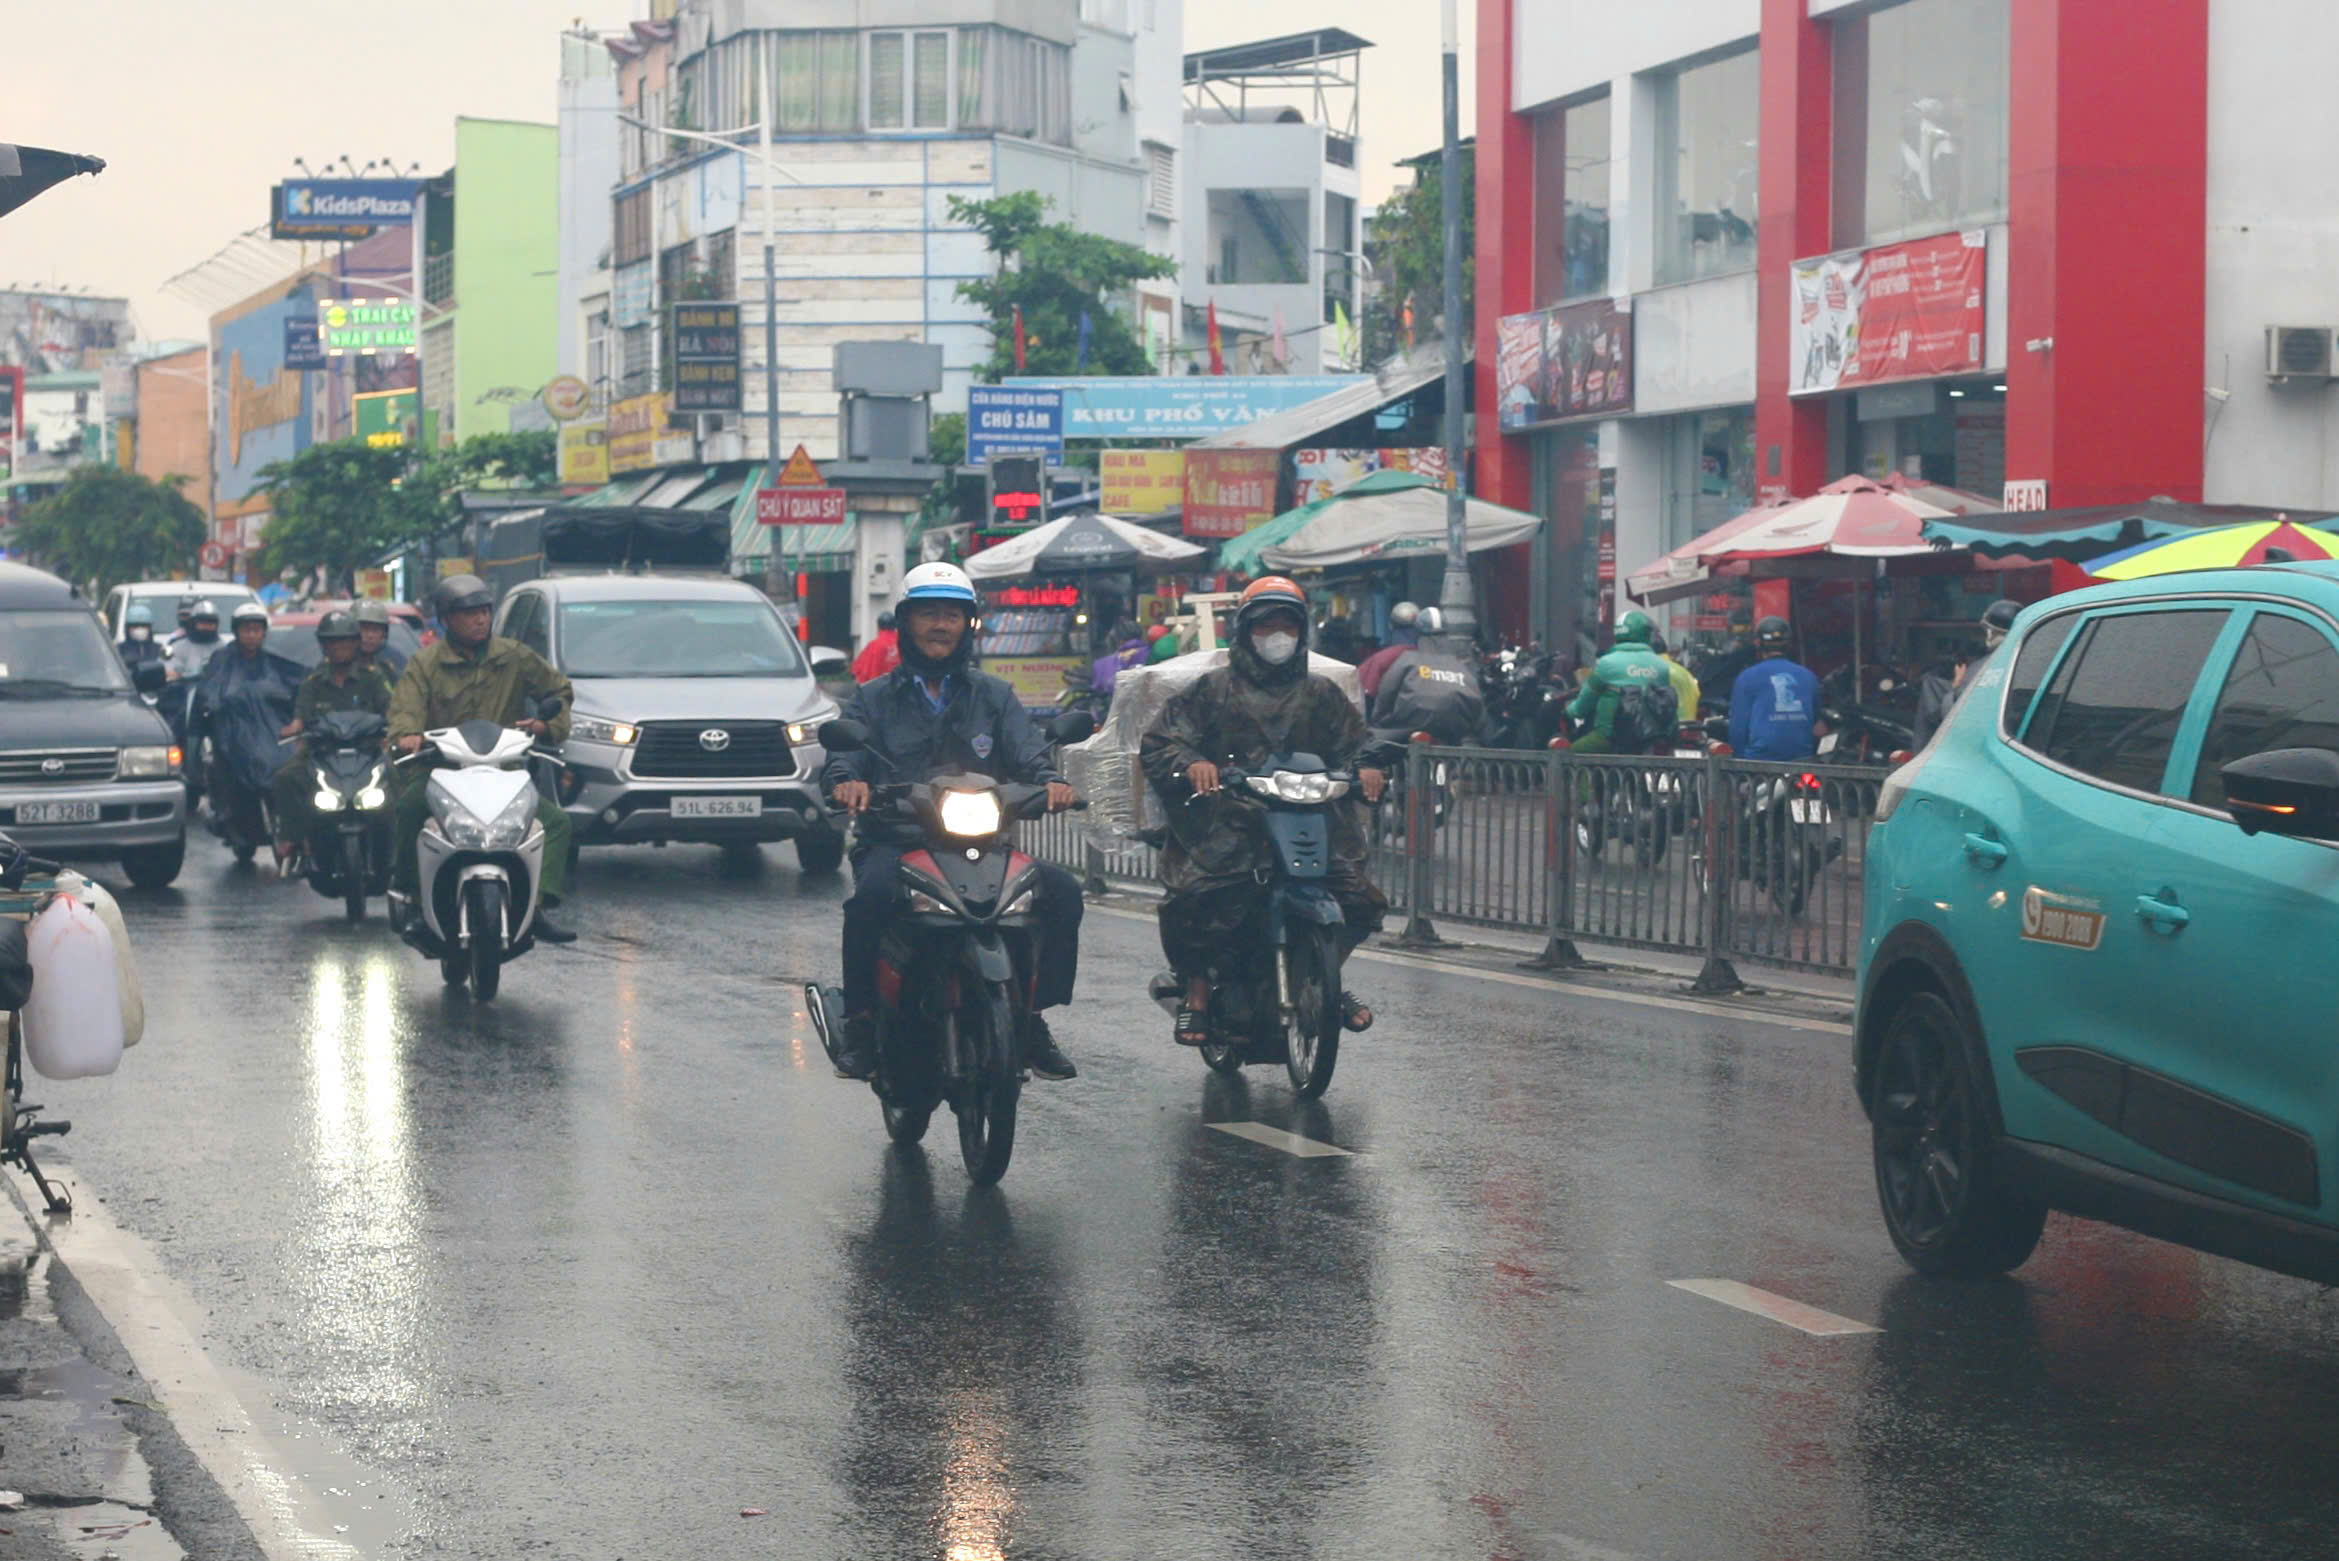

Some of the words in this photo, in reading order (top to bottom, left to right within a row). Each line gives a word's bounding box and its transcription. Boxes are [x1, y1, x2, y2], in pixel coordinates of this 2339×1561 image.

[313, 195, 411, 215] KidsPlaza
[981, 408, 1013, 429] CHÚ
[1015, 409, 1050, 429] SÂM
[1072, 408, 1135, 422] KHU
[1144, 402, 1205, 422] PHỐ
[759, 495, 781, 518] CHÚ
[781, 493, 792, 518] Ý
[791, 498, 821, 519] QUAN
[822, 495, 844, 518] SÁT
[2007, 488, 2043, 512] HEAD
[1627, 664, 1657, 678] Grab
